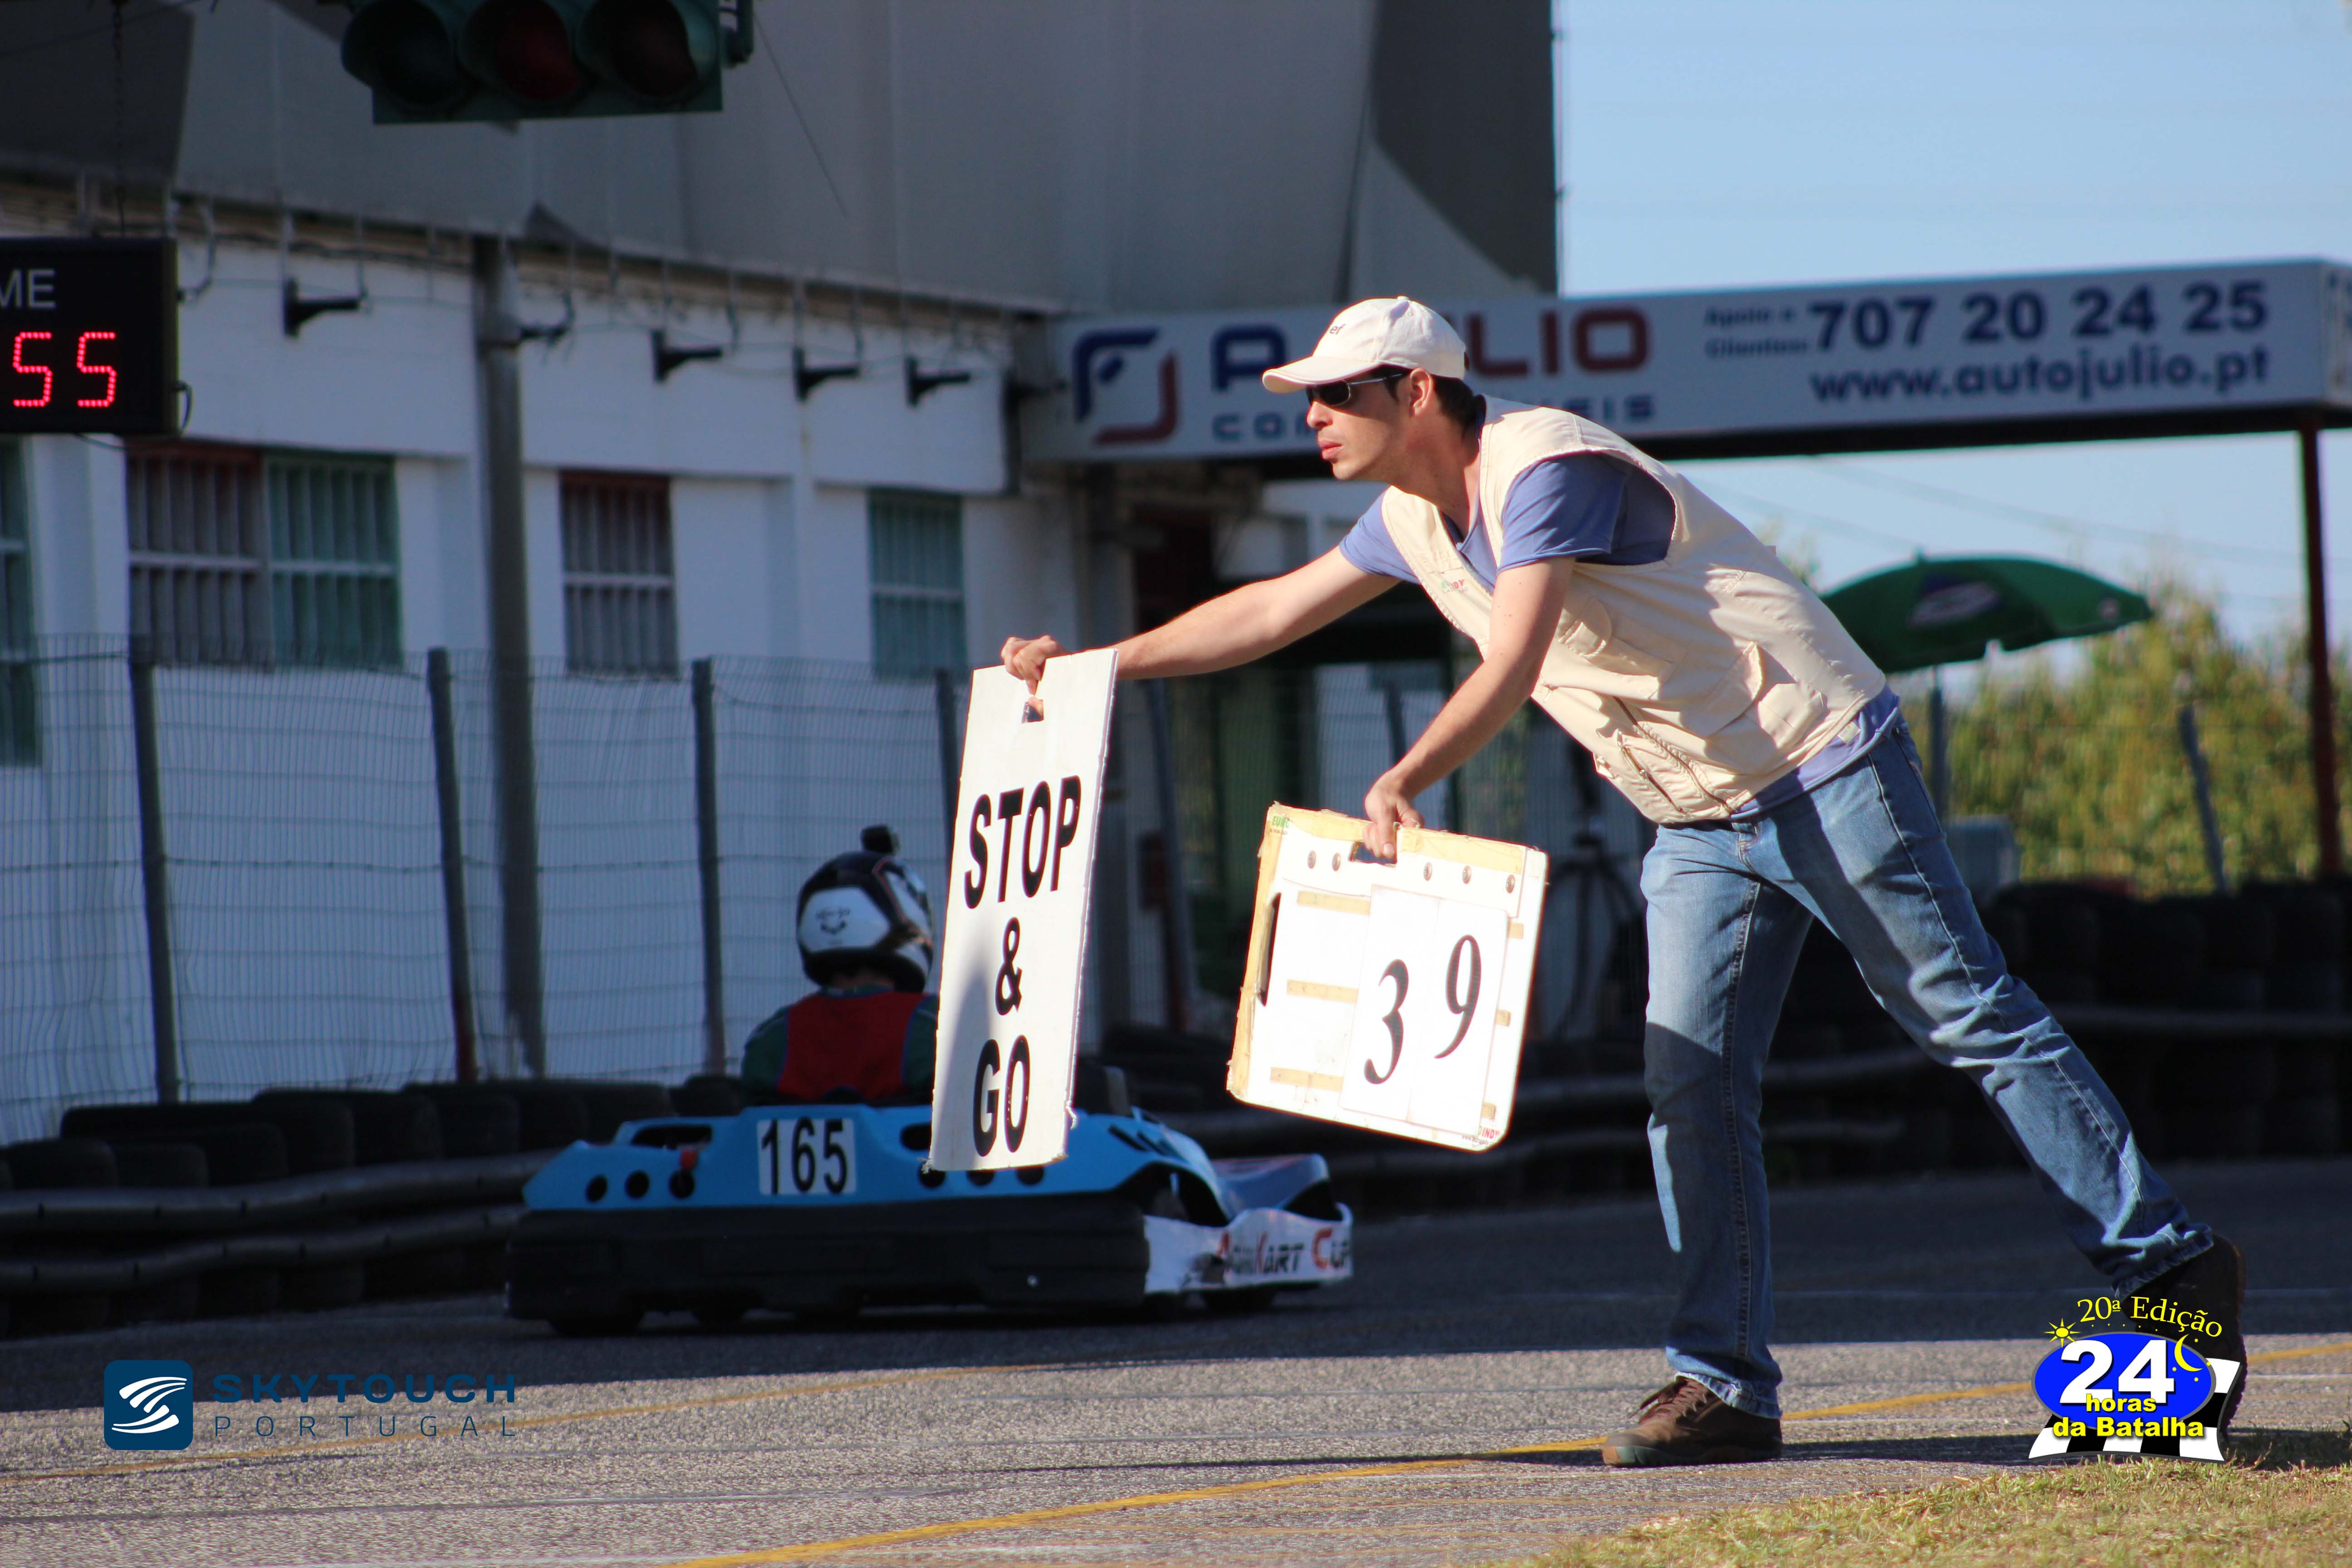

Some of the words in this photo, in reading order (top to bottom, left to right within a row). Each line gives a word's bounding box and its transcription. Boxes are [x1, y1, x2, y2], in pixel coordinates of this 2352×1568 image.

[1808, 295, 1935, 351] 707
[1962, 290, 2048, 342] 20
[2071, 284, 2157, 335] 24
[2182, 280, 2268, 333] 25
[1809, 344, 2268, 402] www.autojulio.pt
[965, 775, 1081, 909] STOP
[995, 916, 1022, 1016] &
[1364, 934, 1482, 1084] 39
[972, 1034, 1030, 1156] GO
[761, 1117, 848, 1195] 165
